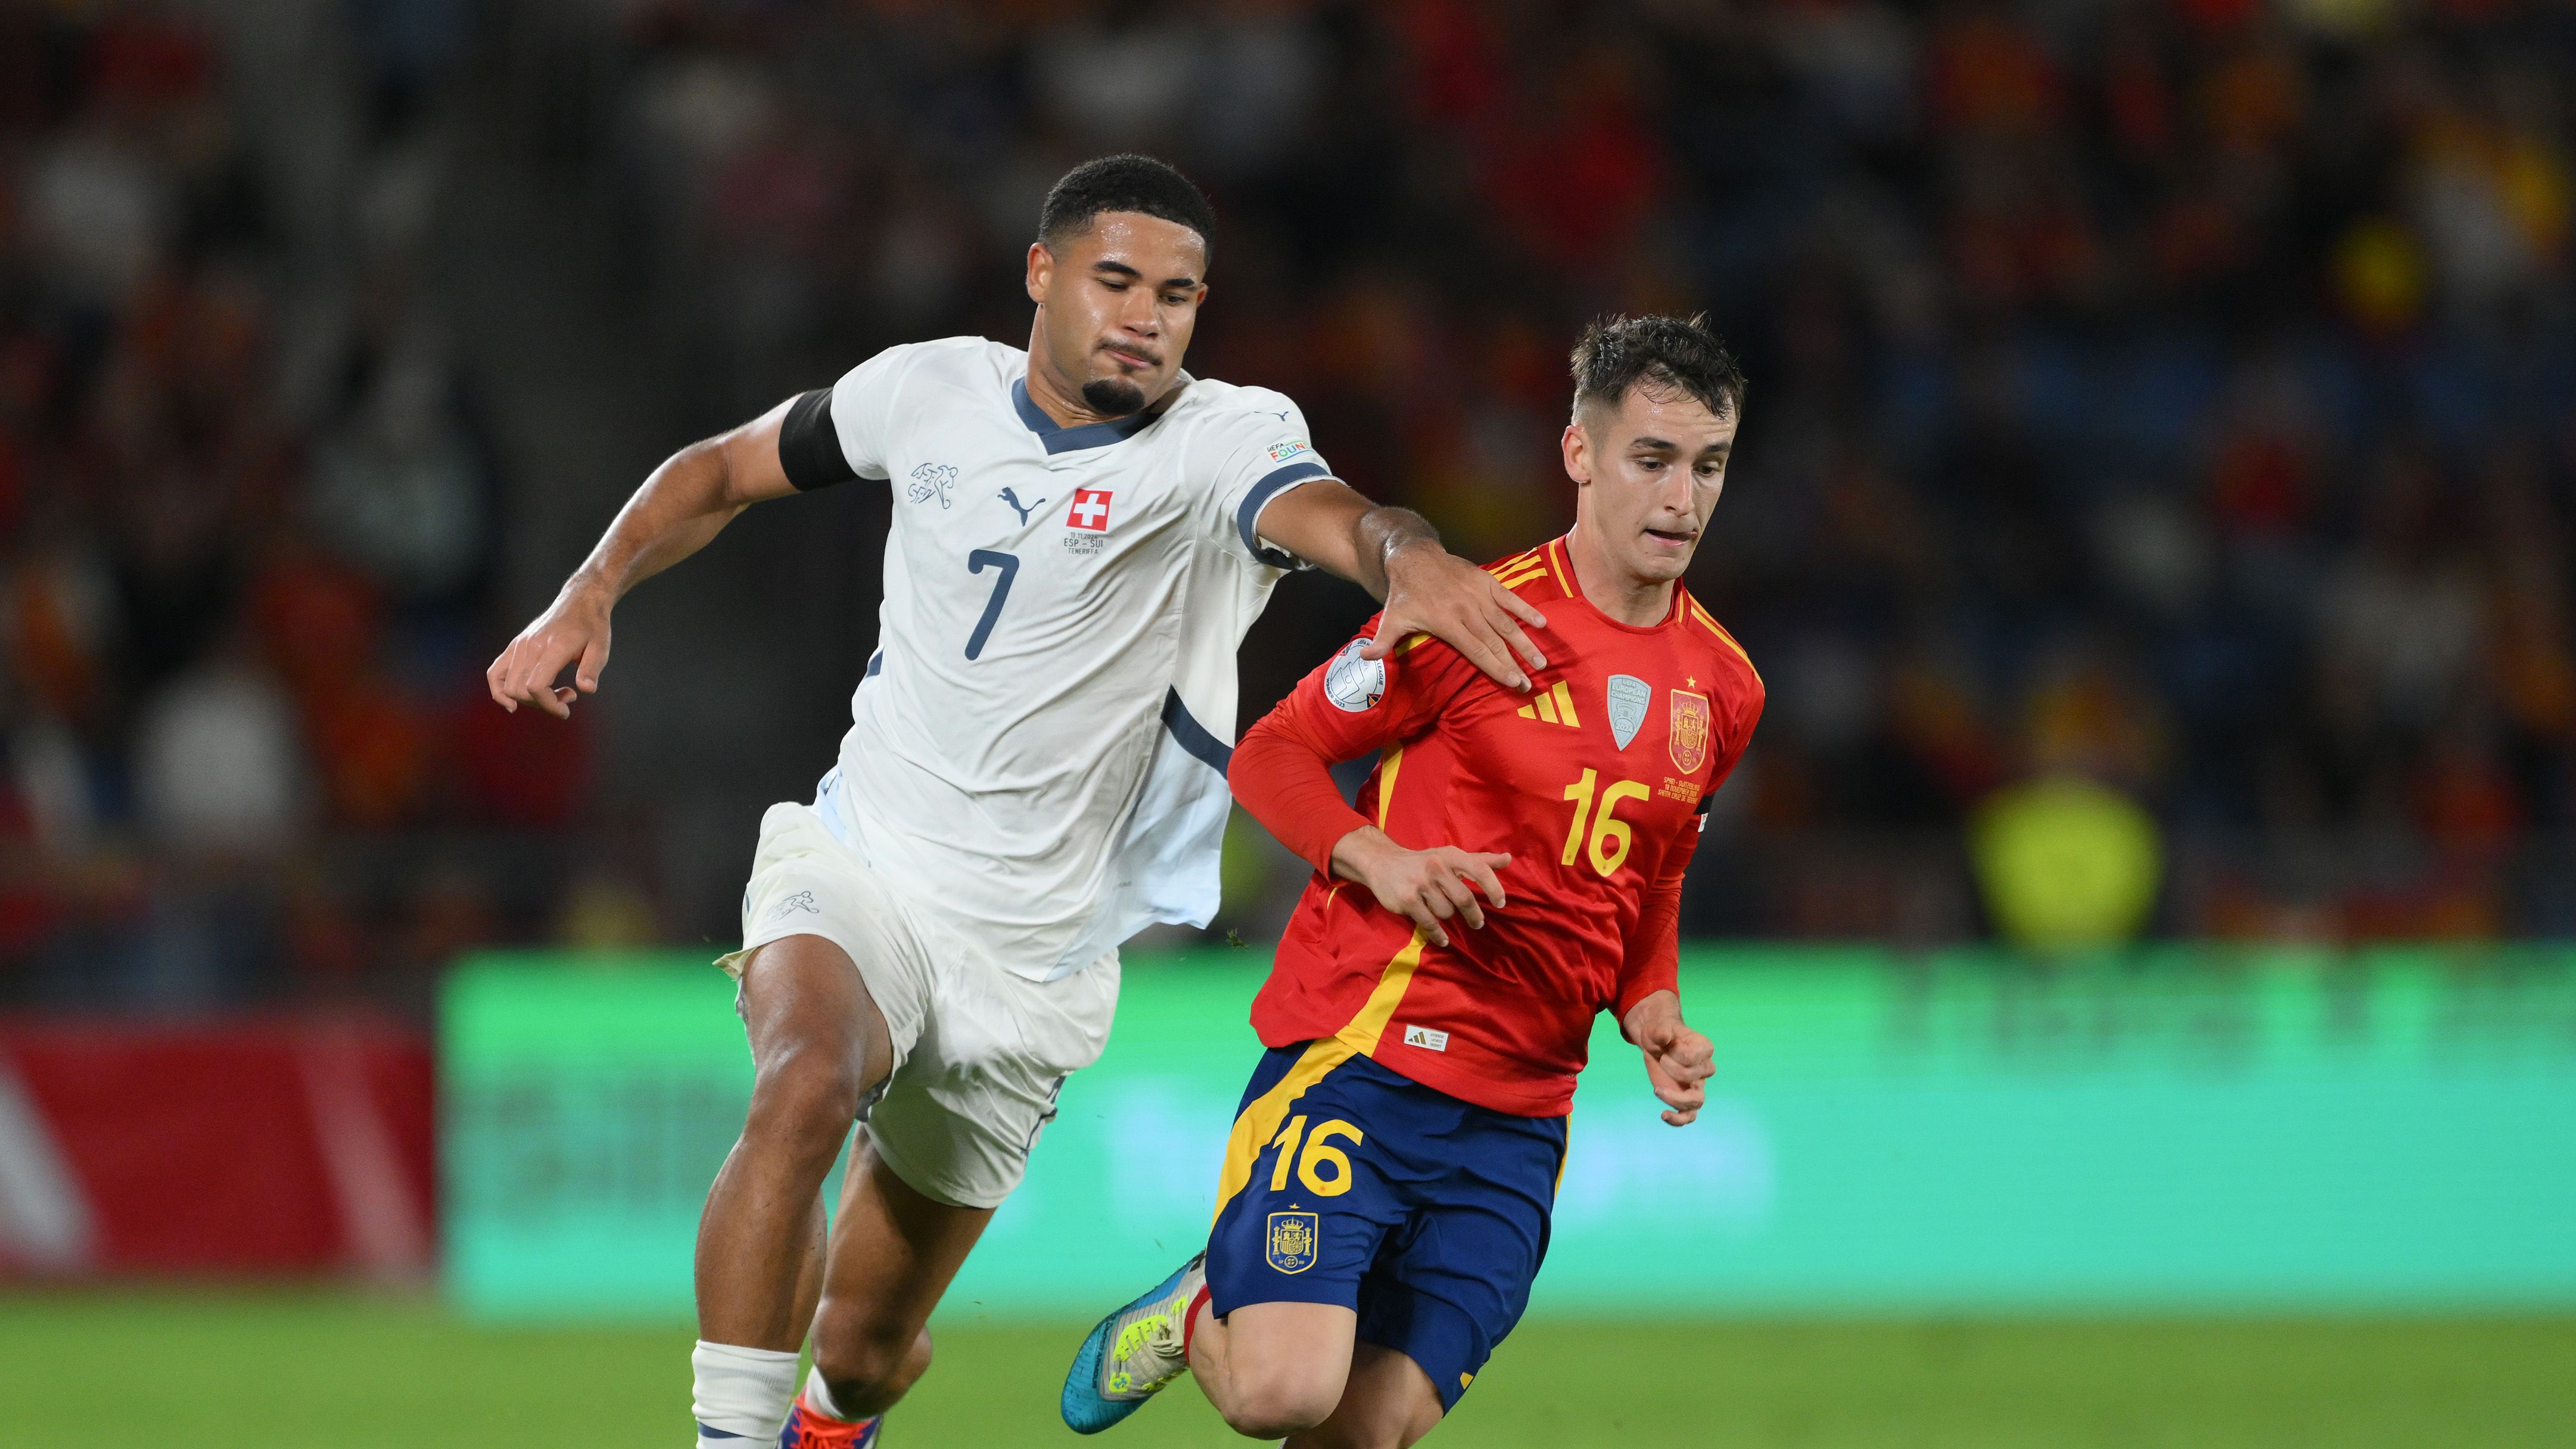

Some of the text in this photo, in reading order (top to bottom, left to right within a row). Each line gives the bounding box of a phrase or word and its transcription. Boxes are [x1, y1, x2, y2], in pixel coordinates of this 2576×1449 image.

[1267, 443, 1284, 452] UEFA
[1064, 538, 1079, 547] ESP
[1090, 539, 1103, 548] SUI
[965, 549, 1019, 660] 7
[1612, 685, 1646, 697] EUROPEAN
[1333, 698, 1345, 708] 2023
[1611, 691, 1645, 704] CHAMPIONS
[1615, 724, 1633, 733] 2024
[1561, 768, 1650, 877] 16
[1270, 1115, 1363, 1197] 16
